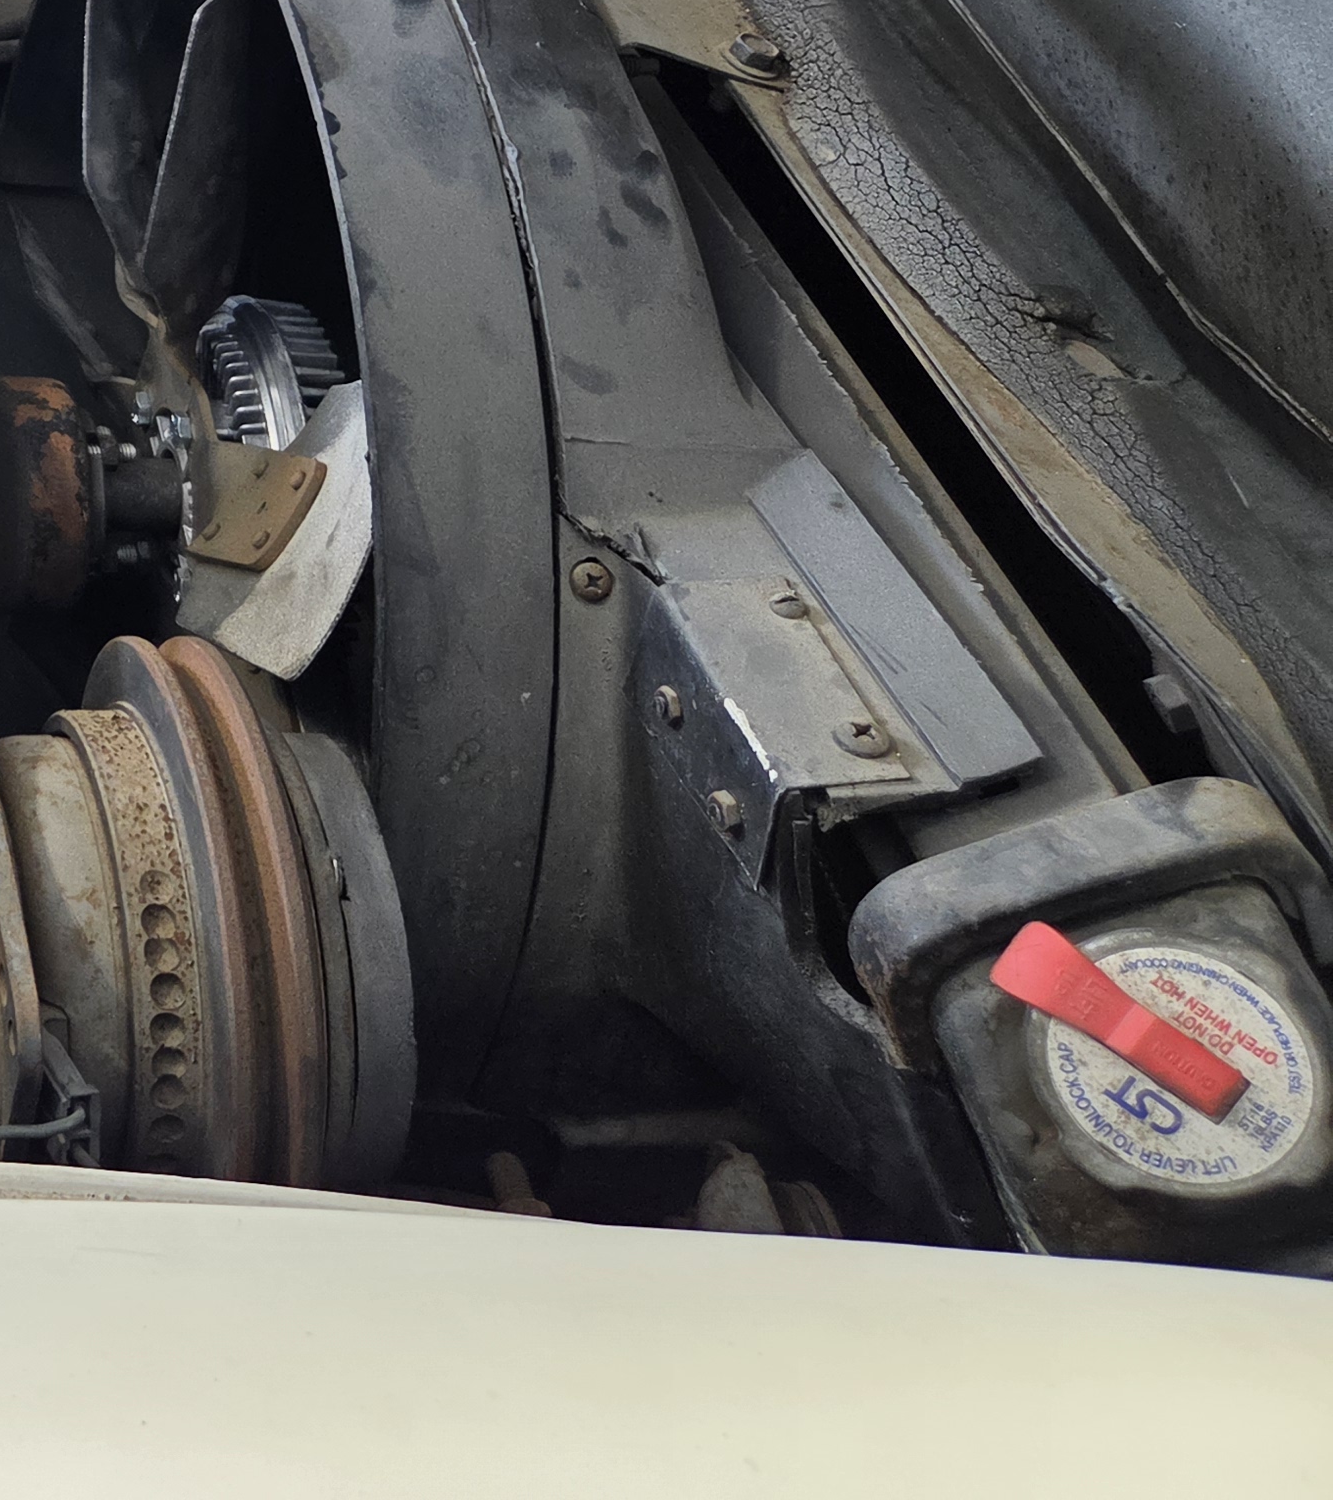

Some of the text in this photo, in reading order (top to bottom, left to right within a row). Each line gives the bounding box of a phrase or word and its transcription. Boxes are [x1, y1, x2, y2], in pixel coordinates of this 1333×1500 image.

[1170, 958, 1231, 986] CHANGING
[1228, 980, 1261, 1009] WHEN
[1150, 972, 1279, 1066] OPEN WHEN HOT
[1172, 1009, 1235, 1056] DO NOT
[1257, 1004, 1293, 1051] REPLACE
[1057, 1042, 1238, 1176] LIFT LEVER TO UNLOCK CAP
